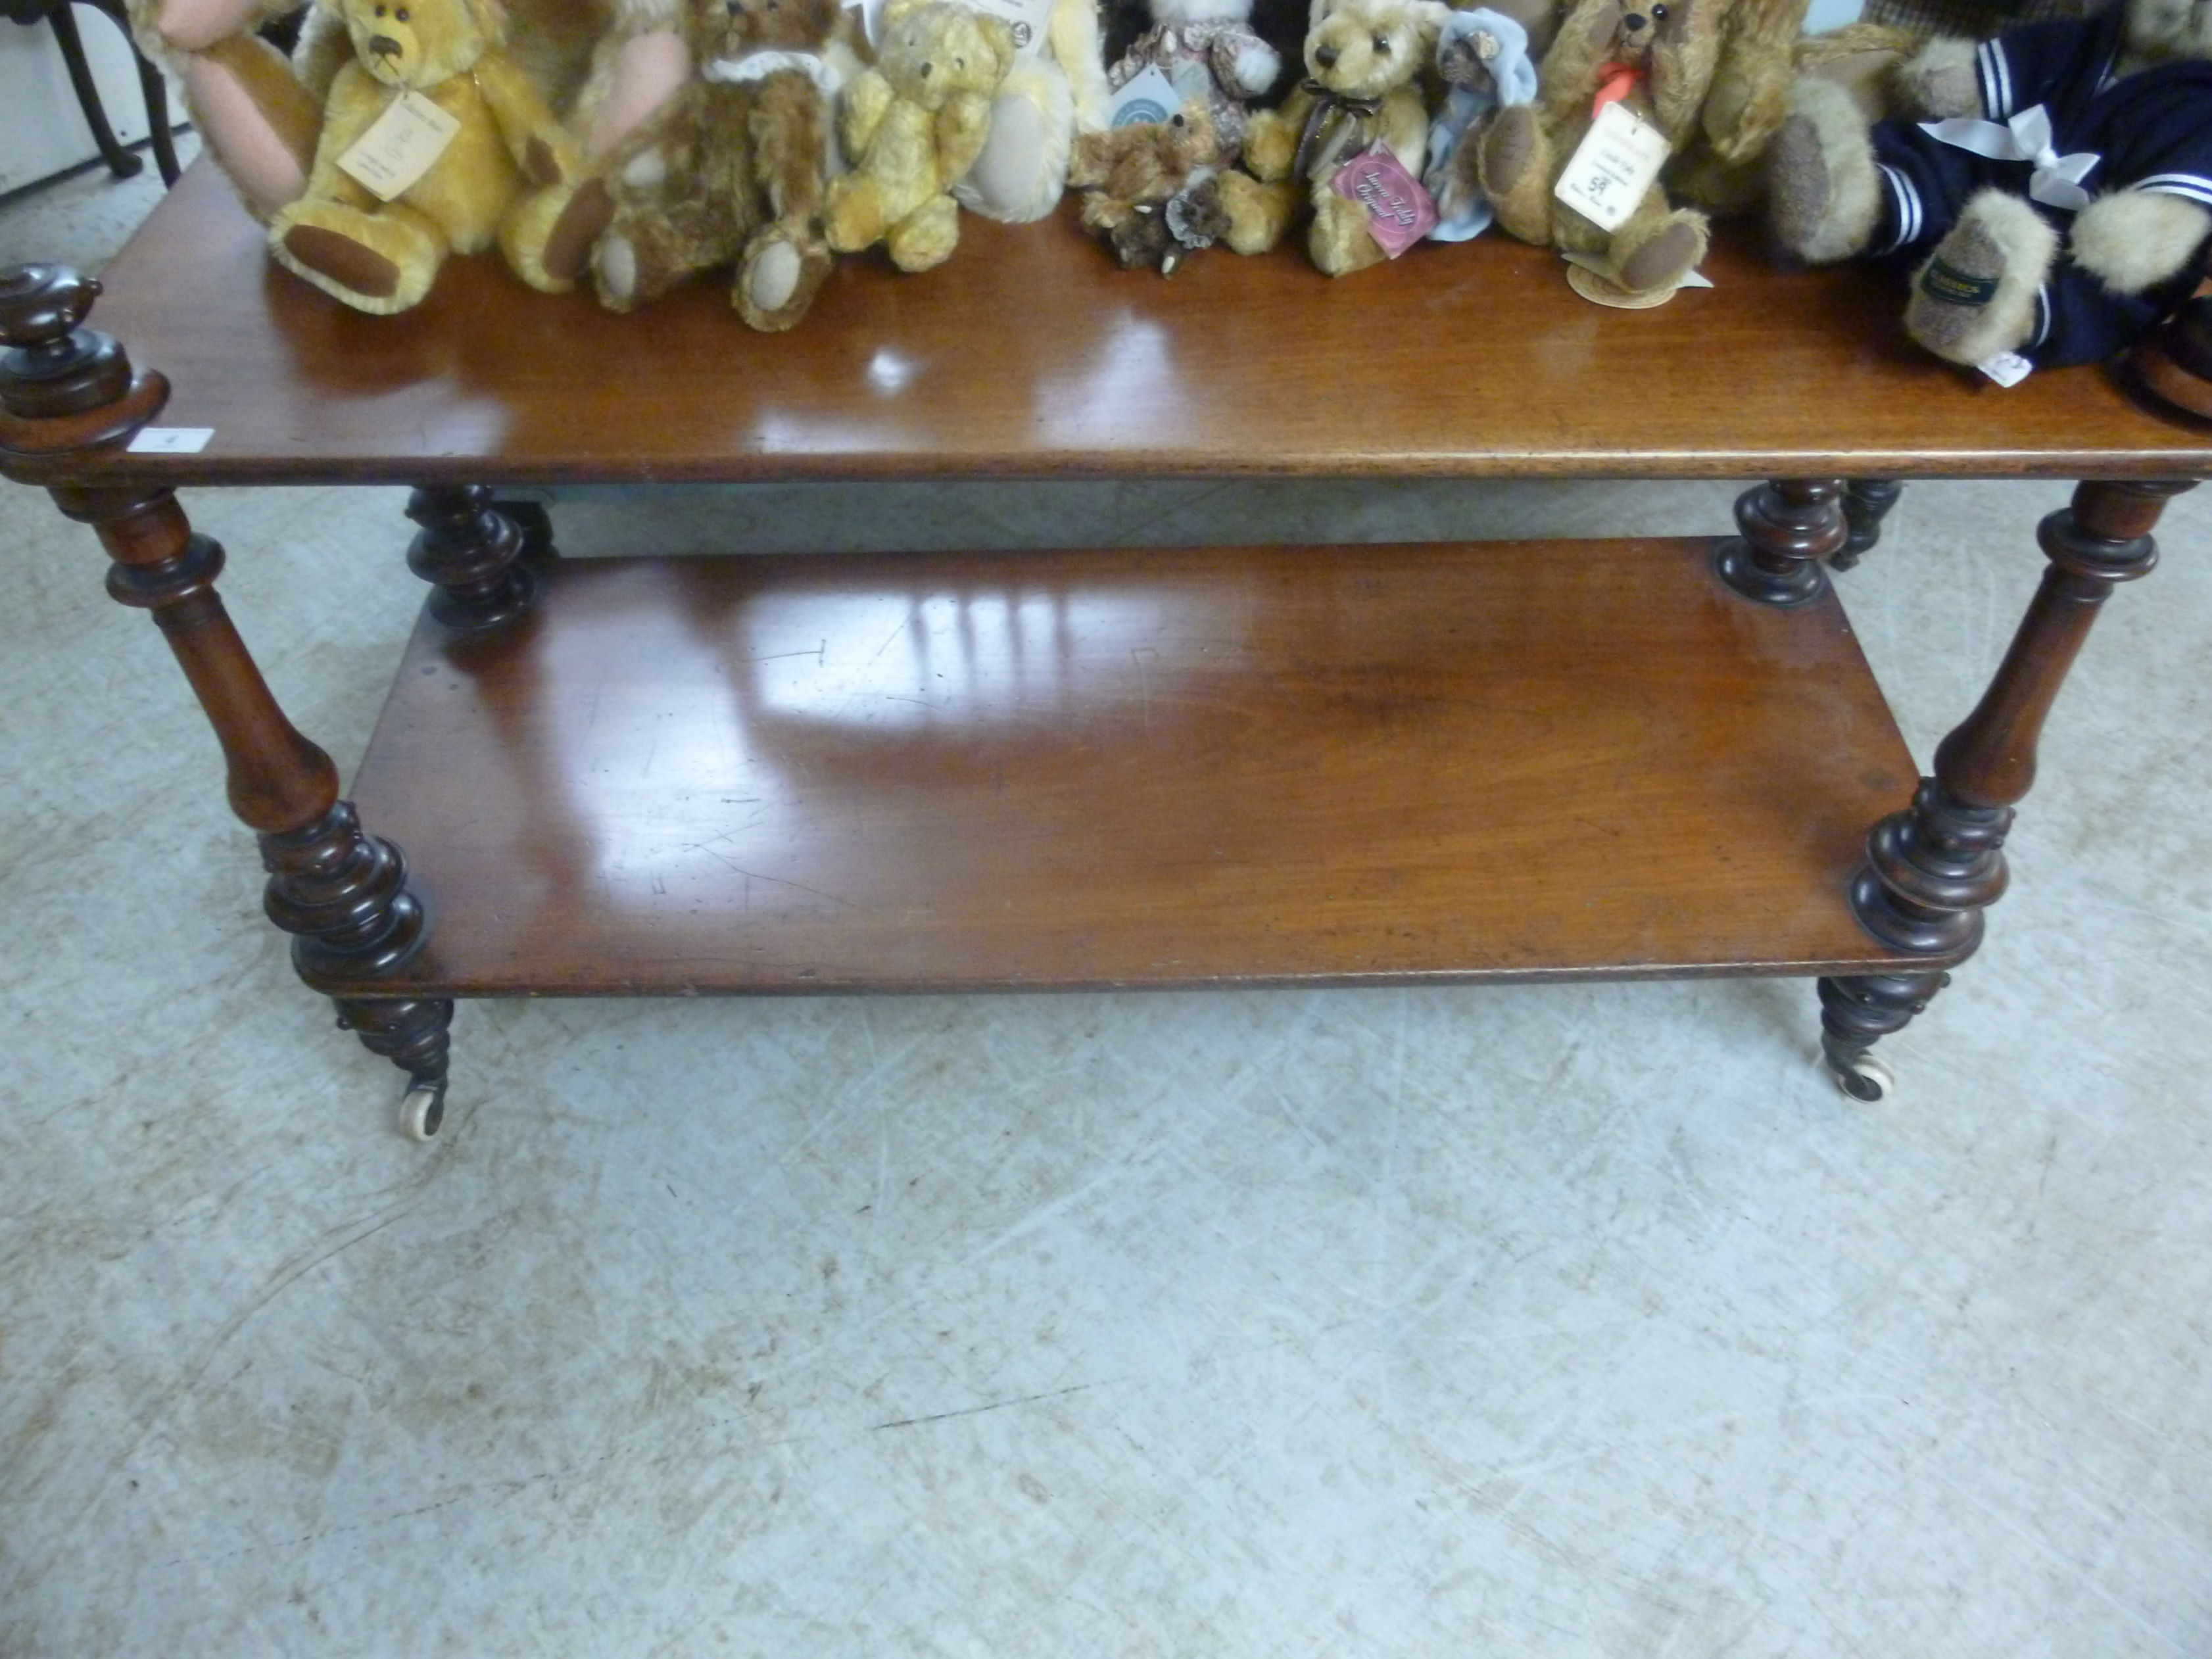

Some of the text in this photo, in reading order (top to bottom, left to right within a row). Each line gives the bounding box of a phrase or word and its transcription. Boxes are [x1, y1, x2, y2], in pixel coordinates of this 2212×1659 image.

[1357, 184, 1395, 218] Original
[1361, 170, 1416, 226] Aurora Teddy
